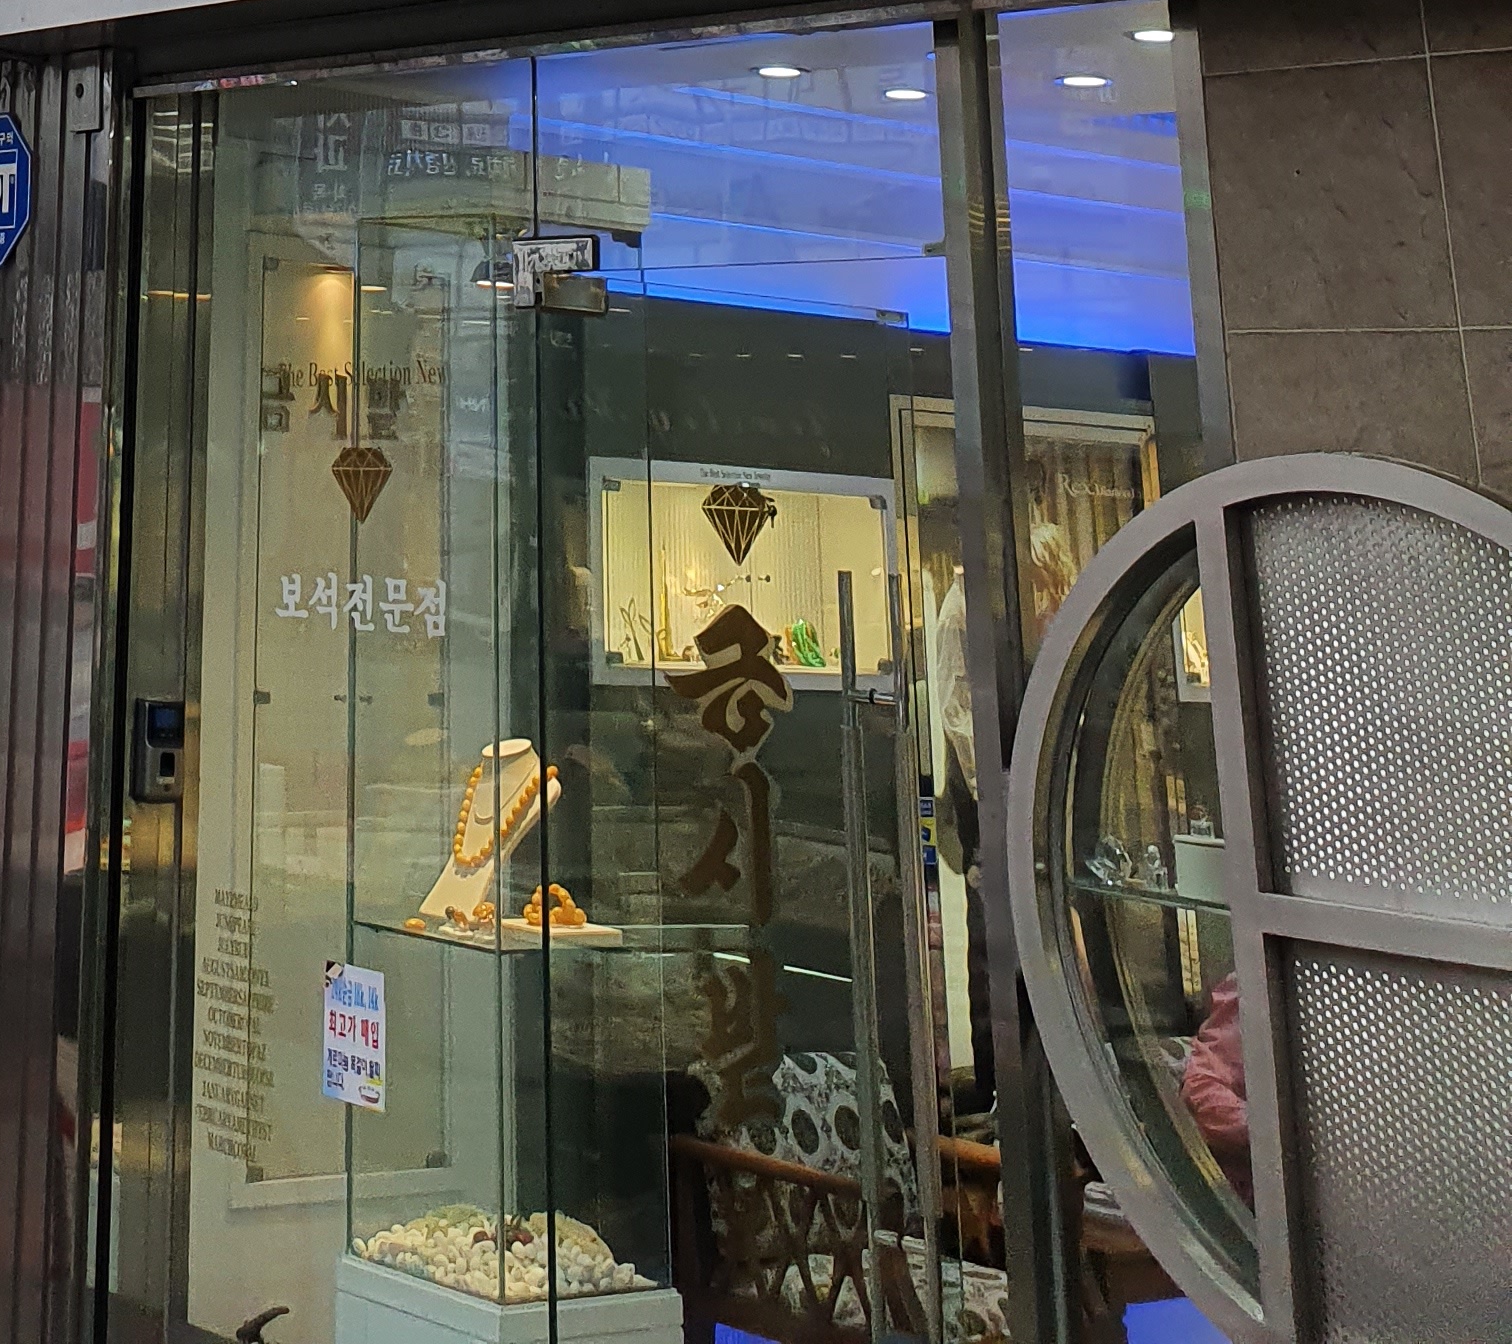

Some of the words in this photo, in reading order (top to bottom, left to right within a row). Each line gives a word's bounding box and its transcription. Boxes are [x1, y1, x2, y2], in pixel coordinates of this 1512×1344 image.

[344, 362, 411, 386] Slection
[275, 572, 448, 639] 보석전문점
[328, 1009, 356, 1043] 최고가
